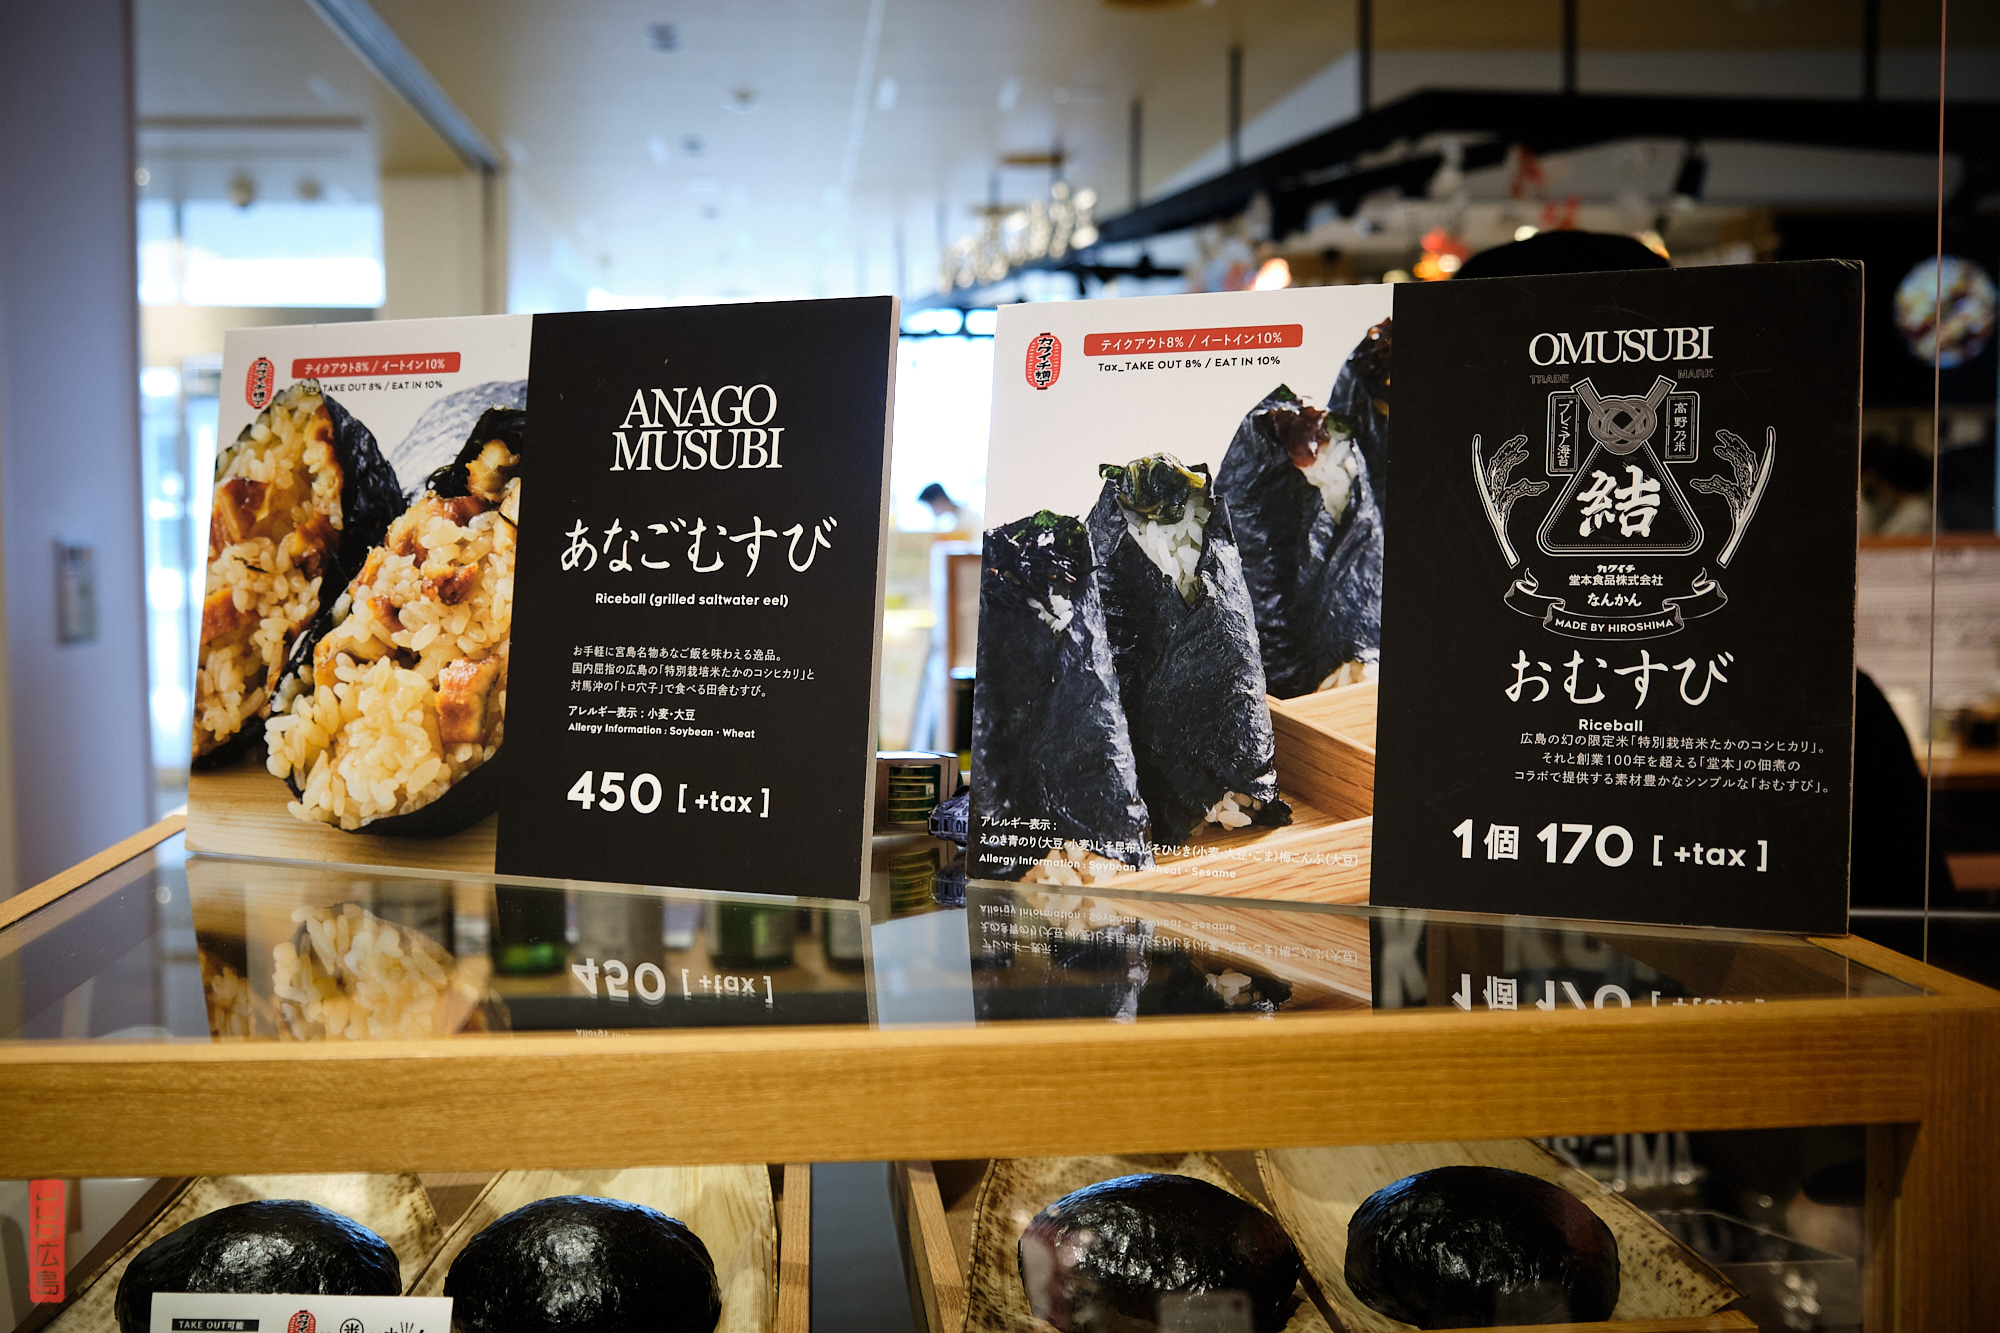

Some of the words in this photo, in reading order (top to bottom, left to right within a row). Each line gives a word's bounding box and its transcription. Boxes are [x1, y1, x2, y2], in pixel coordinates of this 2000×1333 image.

[1101, 337, 1184, 351] テイクアウト8%
[1201, 332, 1282, 347] イートイン10%
[1528, 326, 1714, 366] OMUSUBI
[304, 362, 369, 375] テイクアウト8%
[382, 358, 445, 372] イートイン10%
[1035, 337, 1054, 386] カクイチ横丁
[1098, 361, 1154, 372] Tax_TAKE
[1158, 360, 1182, 369] OUT
[1185, 359, 1202, 368] 8%
[1215, 358, 1238, 367] EAT
[1241, 357, 1253, 366] IN
[1257, 356, 1281, 366] 10%
[347, 383, 367, 391] OUT
[369, 383, 382, 391] 8%
[392, 381, 410, 389] EAT
[412, 380, 422, 388] IN
[425, 380, 443, 388] 10%
[1529, 374, 1570, 384] TRADE
[1678, 369, 1714, 379] MARK
[619, 384, 777, 428] ANAGO
[1557, 400, 1574, 467] プレミア海苔
[1673, 402, 1688, 453] 高野乃米
[610, 427, 785, 471] MUSUBI
[1576, 462, 1661, 538] 結
[560, 516, 838, 578] あなごむすび
[1596, 564, 1636, 574] カクイチ
[1568, 574, 1664, 586] 堂本食品株式会社
[595, 593, 646, 605] Riceball
[649, 593, 696, 607] (grilled
[699, 593, 760, 606] saltwater
[763, 594, 789, 608] eel)
[1587, 592, 1642, 607] なんかん
[1555, 618, 1588, 631] MADE
[1590, 623, 1606, 633] BY
[1608, 619, 1674, 633] HIROSHIMA
[573, 645, 781, 662] お手軽に宮島名物あなご飯を味わえる逸品。
[571, 662, 815, 681] 国内屈指の広島の「特別栽培米たかのコシヒカリ」と
[1504, 649, 1734, 710] おむすび
[570, 680, 767, 698] 対馬沖の「トロ穴子」で食べる田舎むすび。
[568, 722, 602, 735] Allergy
[605, 723, 662, 735] Information
[670, 726, 714, 738] Soybean
[722, 728, 755, 739] Wheat
[1578, 718, 1643, 732] Riceball
[1520, 731, 1824, 755] 広島の幻の限定米「特別栽培米たかのコシヒカリ」。
[1541, 751, 1801, 773] それと創業100年を超える「堂本」の佃煮の
[1514, 770, 1829, 794] コラボで提供する素材豊かなシンプルな「おむすび」。
[567, 770, 663, 814] 450
[1536, 822, 1634, 868] 170
[979, 853, 1016, 865] Allergy
[1019, 855, 1080, 869] Information
[1089, 860, 1136, 874] Soybean
[1147, 863, 1182, 875] Wheat
[1191, 867, 1237, 879] Sesame
[179, 1320, 203, 1330] TAKE
